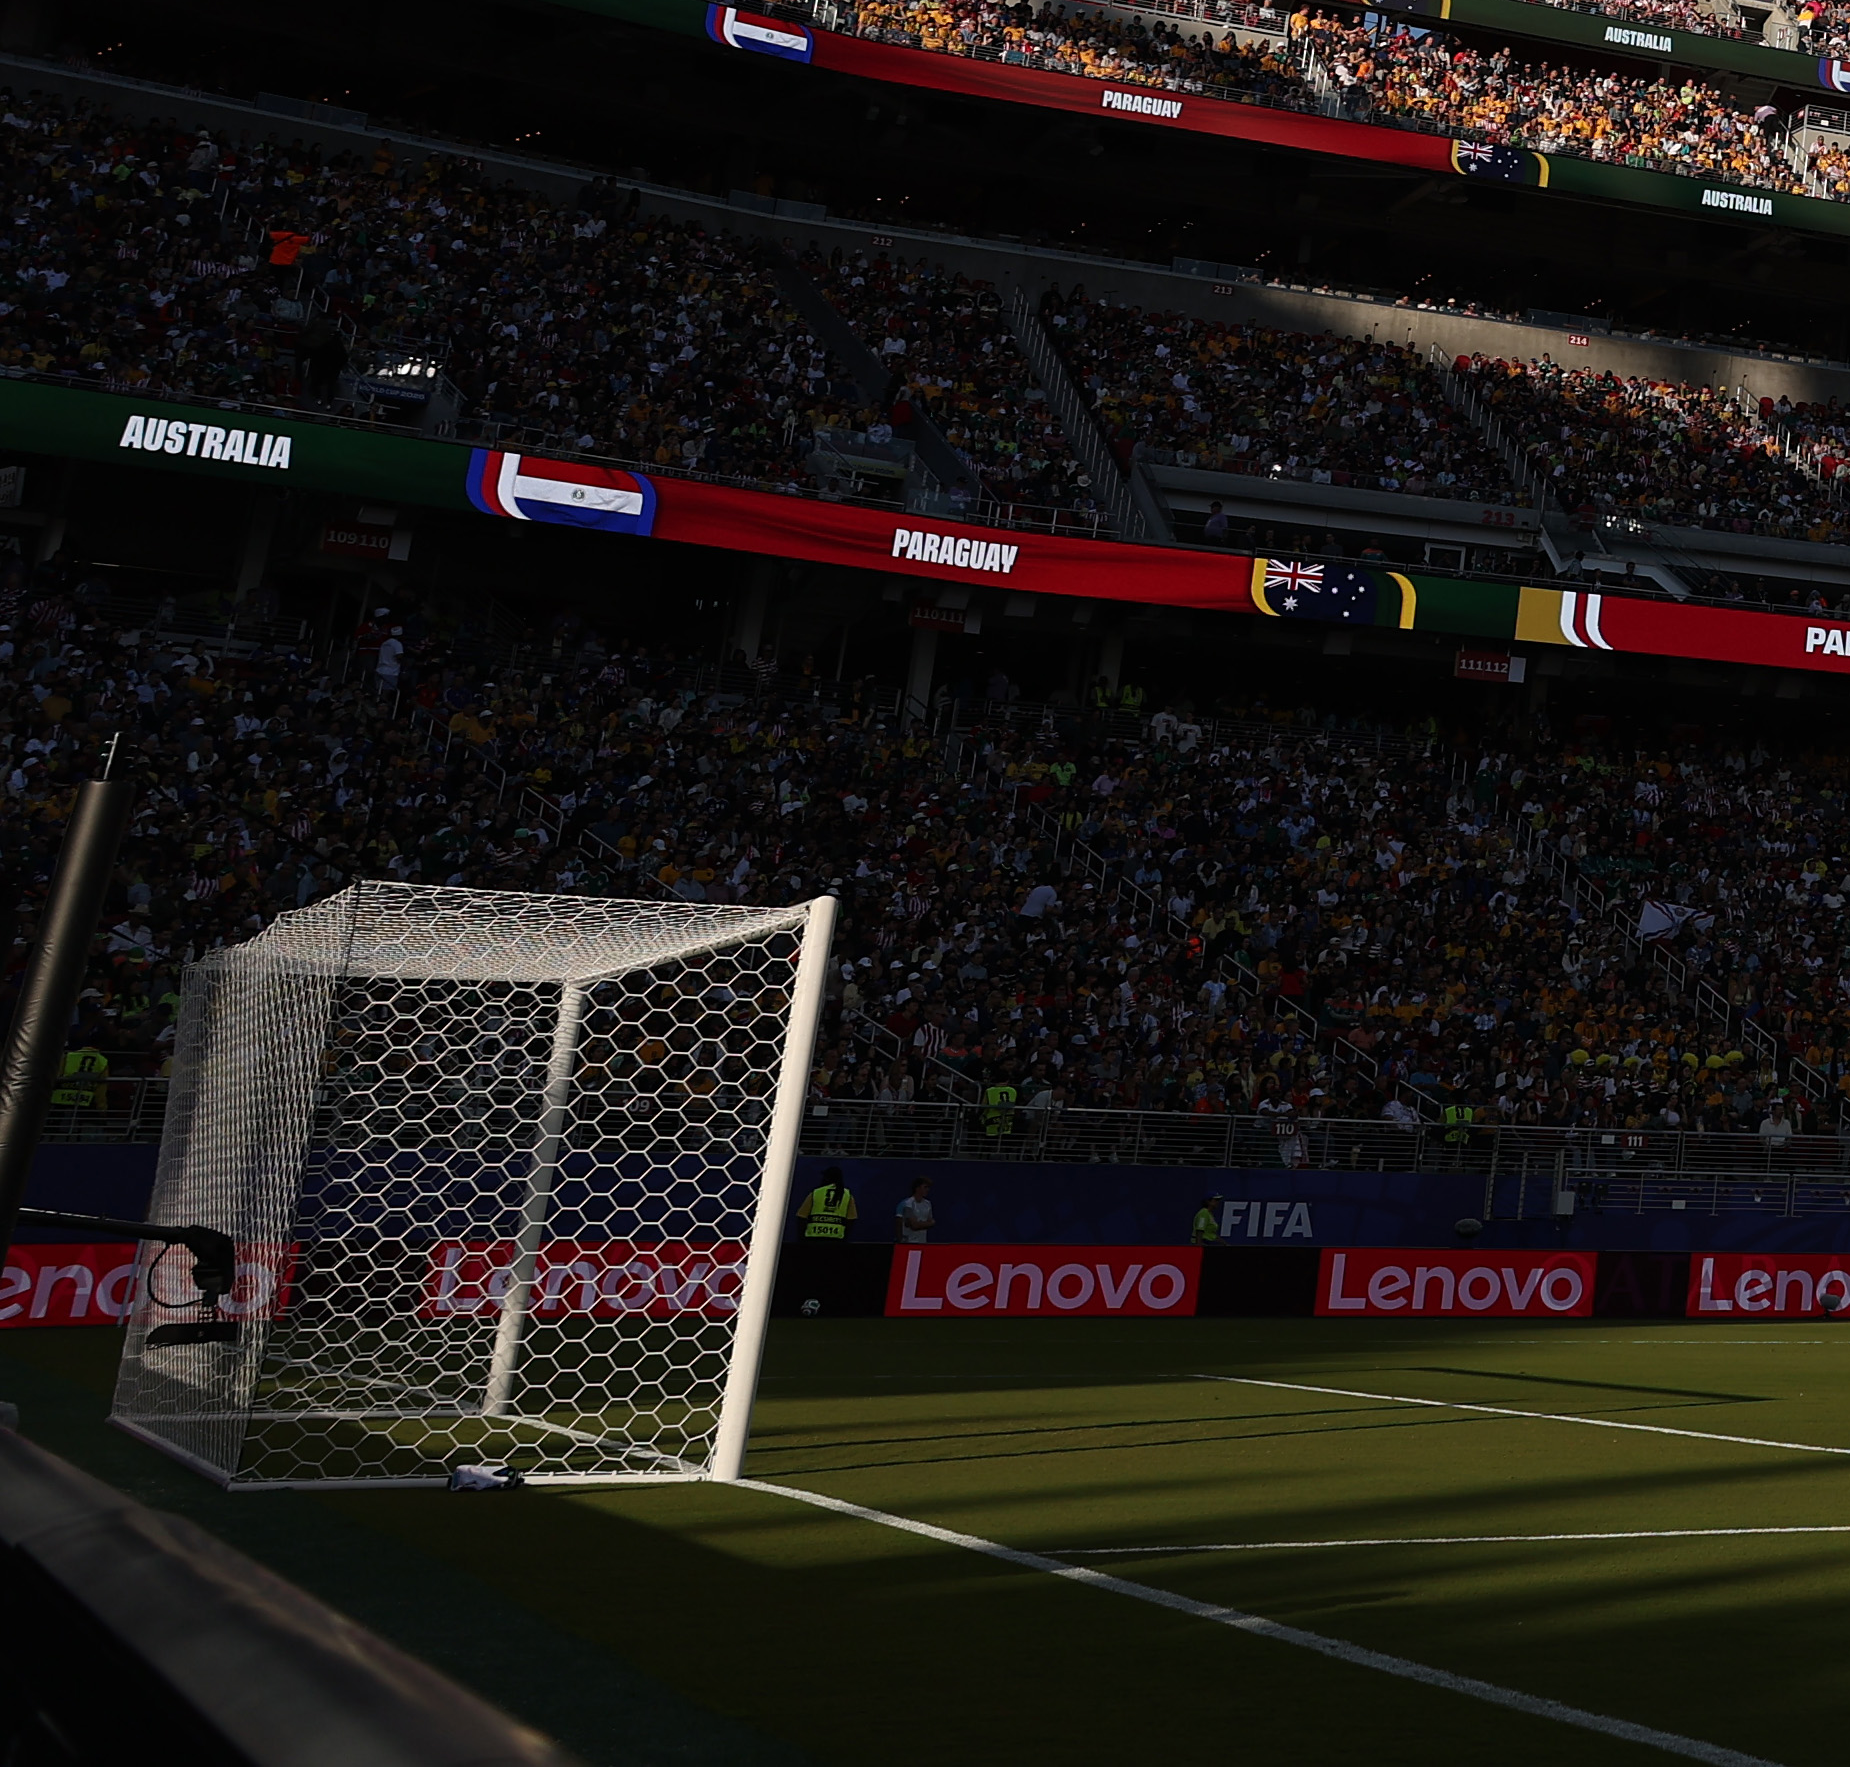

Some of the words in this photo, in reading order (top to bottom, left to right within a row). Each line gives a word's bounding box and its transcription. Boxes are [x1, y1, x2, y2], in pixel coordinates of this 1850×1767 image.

[1605, 27, 1671, 52] AUSTRALIA
[1101, 90, 1182, 119] PARAGUAY
[1702, 190, 1772, 215] AUSTRALIA
[873, 236, 892, 246] 212
[1215, 286, 1232, 294] 213
[1570, 336, 1587, 345] 214
[120, 416, 291, 468] AUSTRALIA
[1482, 510, 1514, 526] 213
[327, 530, 357, 544] 109
[358, 534, 389, 548] 110
[892, 529, 1018, 573] PARAGUAY
[914, 607, 937, 620] 110
[938, 610, 965, 624] 111
[1459, 658, 1484, 671] 111
[1484, 660, 1508, 673] 112
[1275, 1122, 1294, 1134] 110
[1627, 1135, 1643, 1146] 111
[1219, 1201, 1312, 1239] FIFA
[900, 1251, 1185, 1310] Lenovo
[1328, 1253, 1583, 1311] Lenovo
